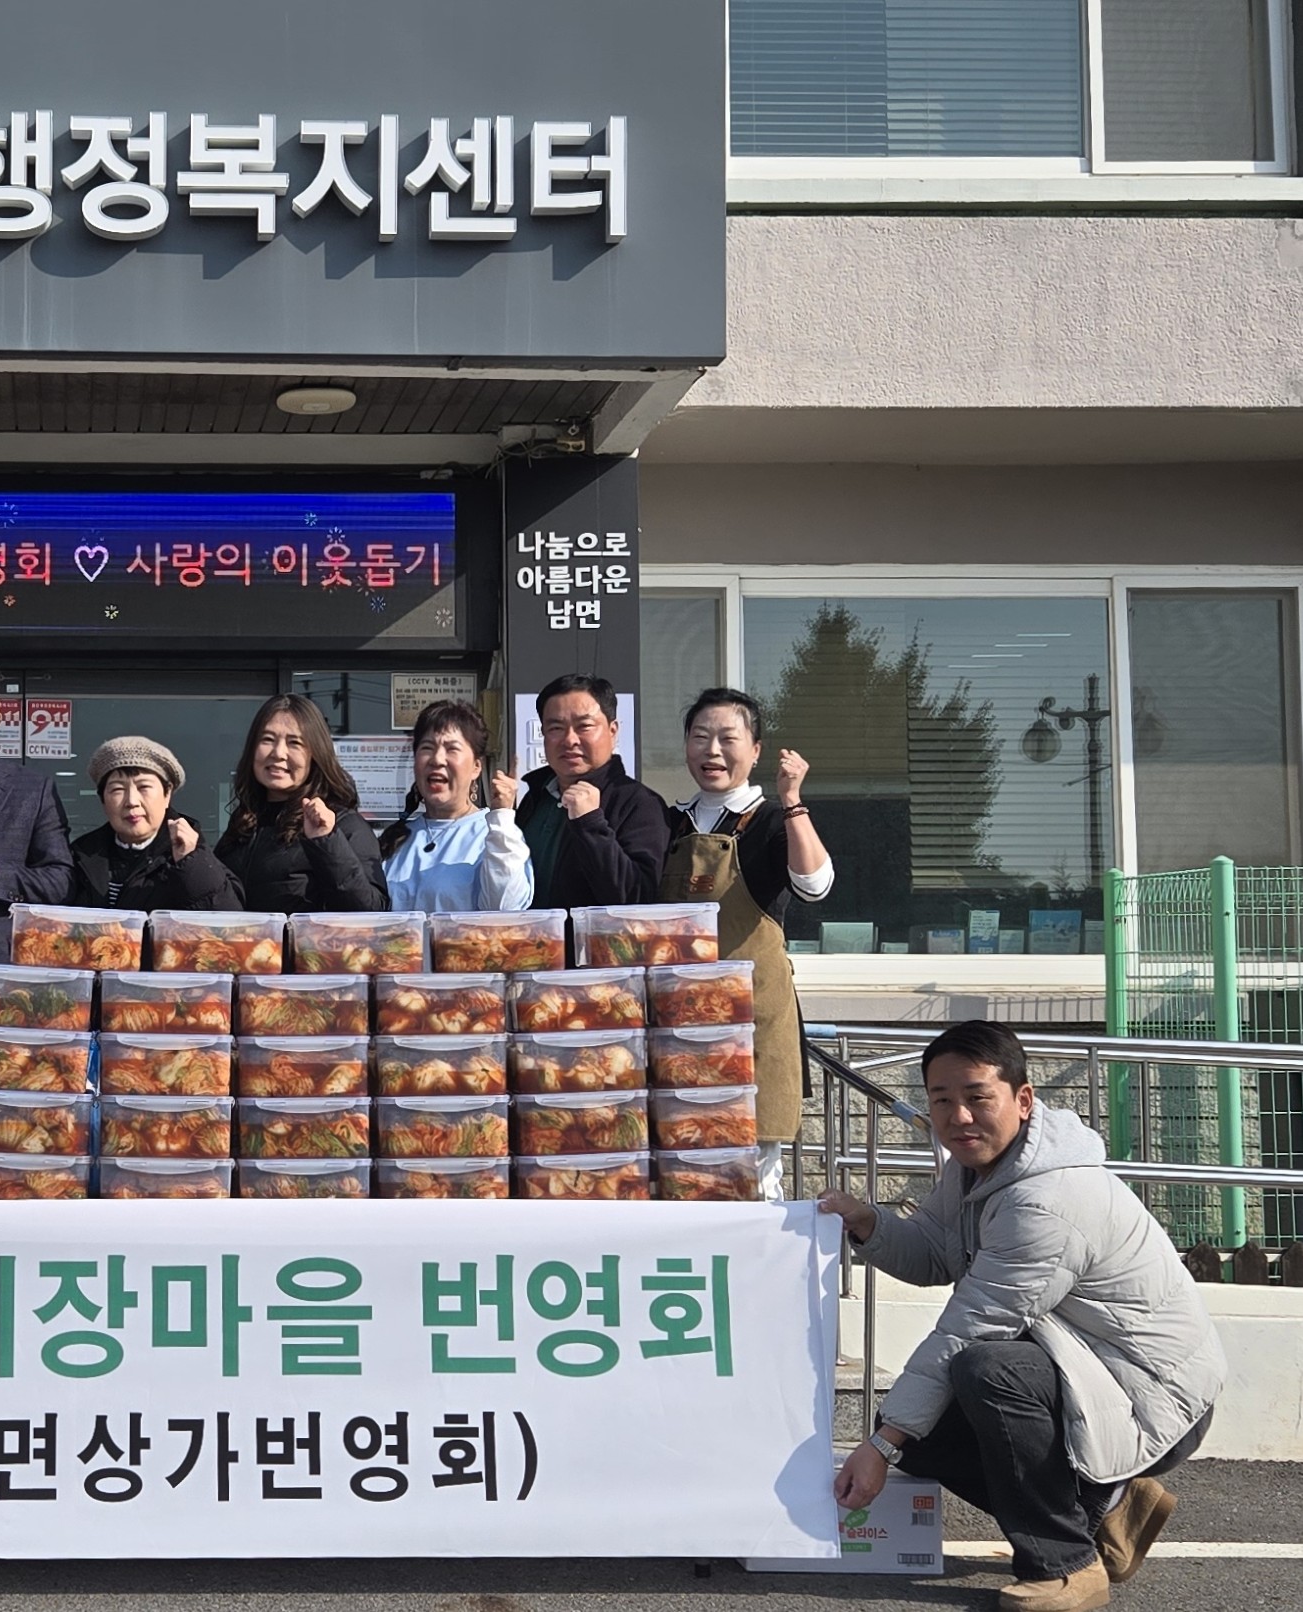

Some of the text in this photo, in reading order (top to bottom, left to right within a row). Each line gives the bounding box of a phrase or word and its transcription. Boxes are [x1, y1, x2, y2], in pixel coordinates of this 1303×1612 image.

[518, 531, 631, 560] 나눔으로
[126, 542, 251, 587] 사랑의
[272, 542, 439, 587] 이웃돕기
[517, 565, 631, 594] 아름다운
[547, 600, 601, 629] 남면
[29, 745, 50, 754] CCTV
[422, 1254, 734, 1378] 번영회
